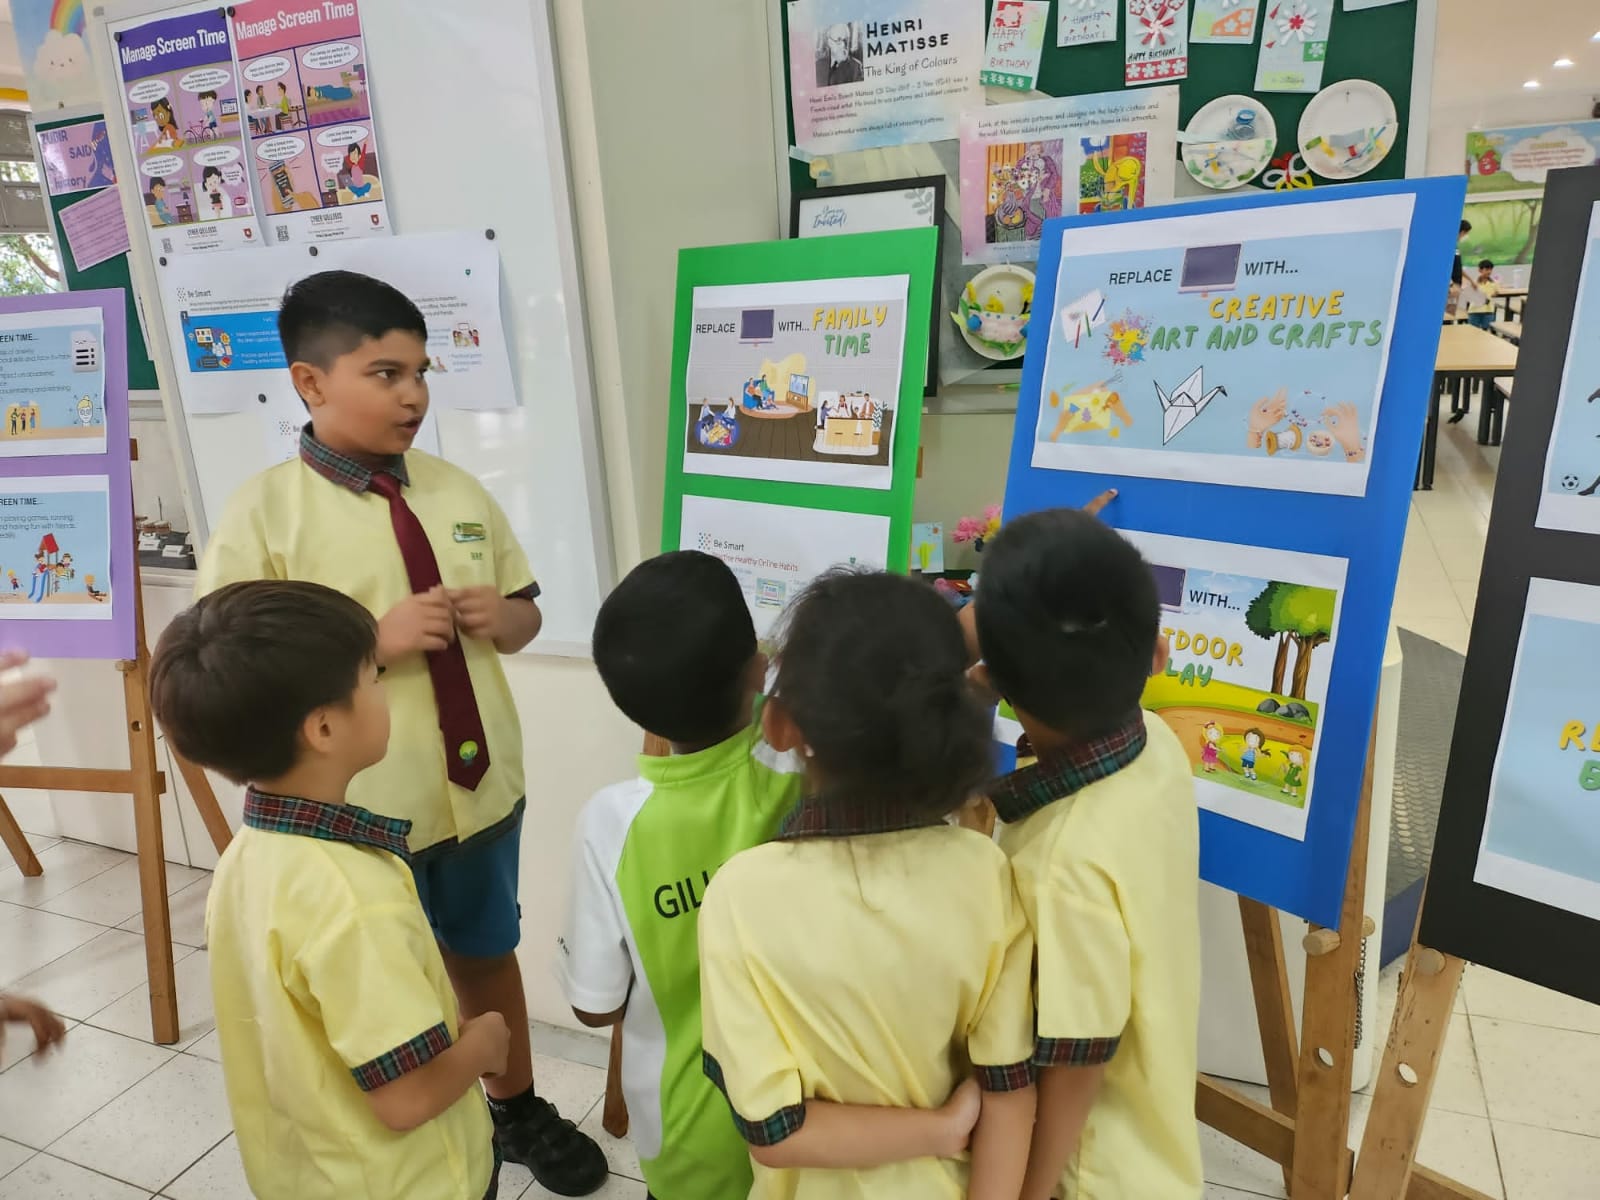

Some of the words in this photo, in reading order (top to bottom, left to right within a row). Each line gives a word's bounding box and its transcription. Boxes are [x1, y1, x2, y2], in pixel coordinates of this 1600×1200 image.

[235, 20, 277, 41] Manage
[277, 9, 322, 30] Screen
[322, 1, 355, 21] Time
[866, 18, 923, 39] HENRI
[992, 28, 1026, 40] HAPPY
[121, 43, 157, 65] Manage
[156, 36, 197, 55] Screen
[196, 28, 227, 47] Time
[866, 33, 950, 59] MATISSE
[865, 65, 883, 78] The
[884, 63, 907, 77] King
[908, 60, 919, 71] of
[920, 56, 958, 70] Colours
[990, 57, 1032, 69] BIRTHDAY
[68, 144, 92, 160] SAID
[1109, 268, 1173, 286] REPLACE
[1244, 259, 1299, 277] WITH...
[812, 304, 889, 332] FAMILY
[1208, 290, 1345, 323] CREATIVE
[696, 322, 736, 334] REPLACE
[778, 321, 810, 334] WITH...
[1150, 324, 1199, 351] ART
[1206, 324, 1259, 351] AND
[1268, 319, 1383, 349] CRAFTS
[823, 332, 872, 358] TIME
[713, 539, 723, 549] Be
[723, 541, 745, 552] Smart
[735, 555, 758, 567] Healthy
[759, 558, 779, 569] Online
[779, 562, 799, 572] Habits
[1189, 589, 1241, 611] WITH...
[1162, 626, 1244, 667] TDOOR
[1164, 657, 1214, 687] LAY
